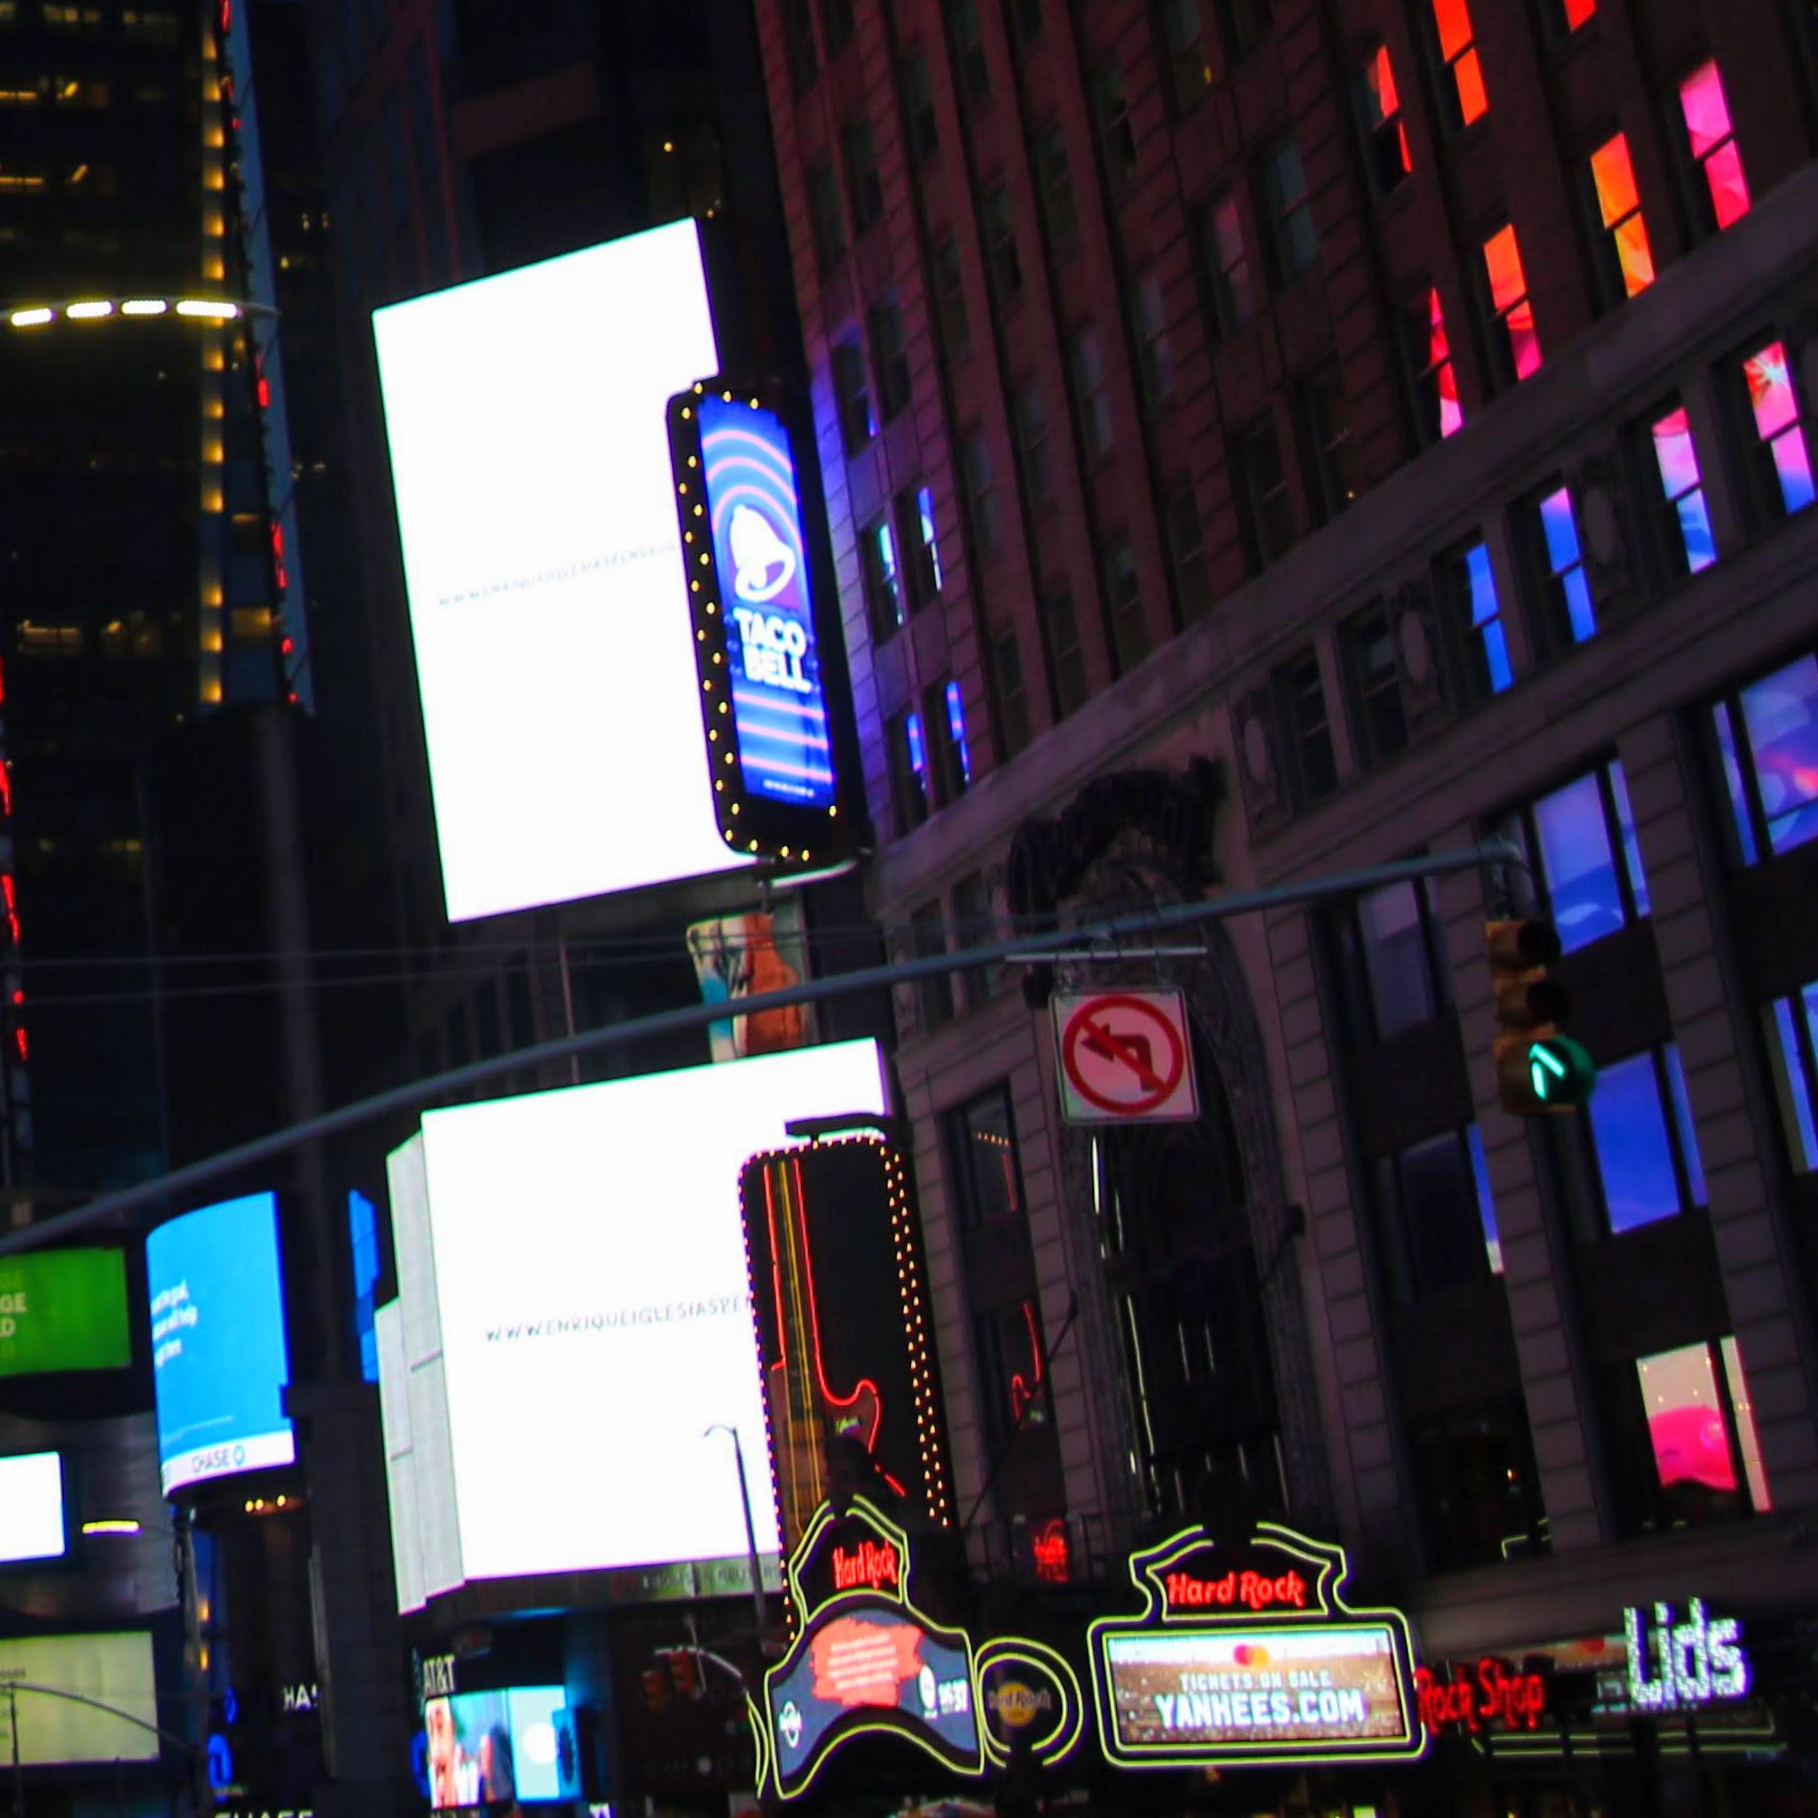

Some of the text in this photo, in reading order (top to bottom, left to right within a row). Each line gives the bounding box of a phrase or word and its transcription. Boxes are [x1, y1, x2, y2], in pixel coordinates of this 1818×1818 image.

[732, 605, 808, 659] TACO
[742, 644, 813, 695] BELL
[191, 1447, 230, 1472] CHASE
[832, 1544, 865, 1590] Hard
[865, 1536, 898, 1590] Rock
[1165, 1569, 1307, 1611] Hard Rock
[1623, 1595, 1754, 1705] Lids
[422, 1654, 457, 1697] AT&T
[1178, 1668, 1334, 1693] TICKETS ON SALE
[1475, 1655, 1546, 1731] Shop
[1153, 1687, 1367, 1730] YANKEES.COM
